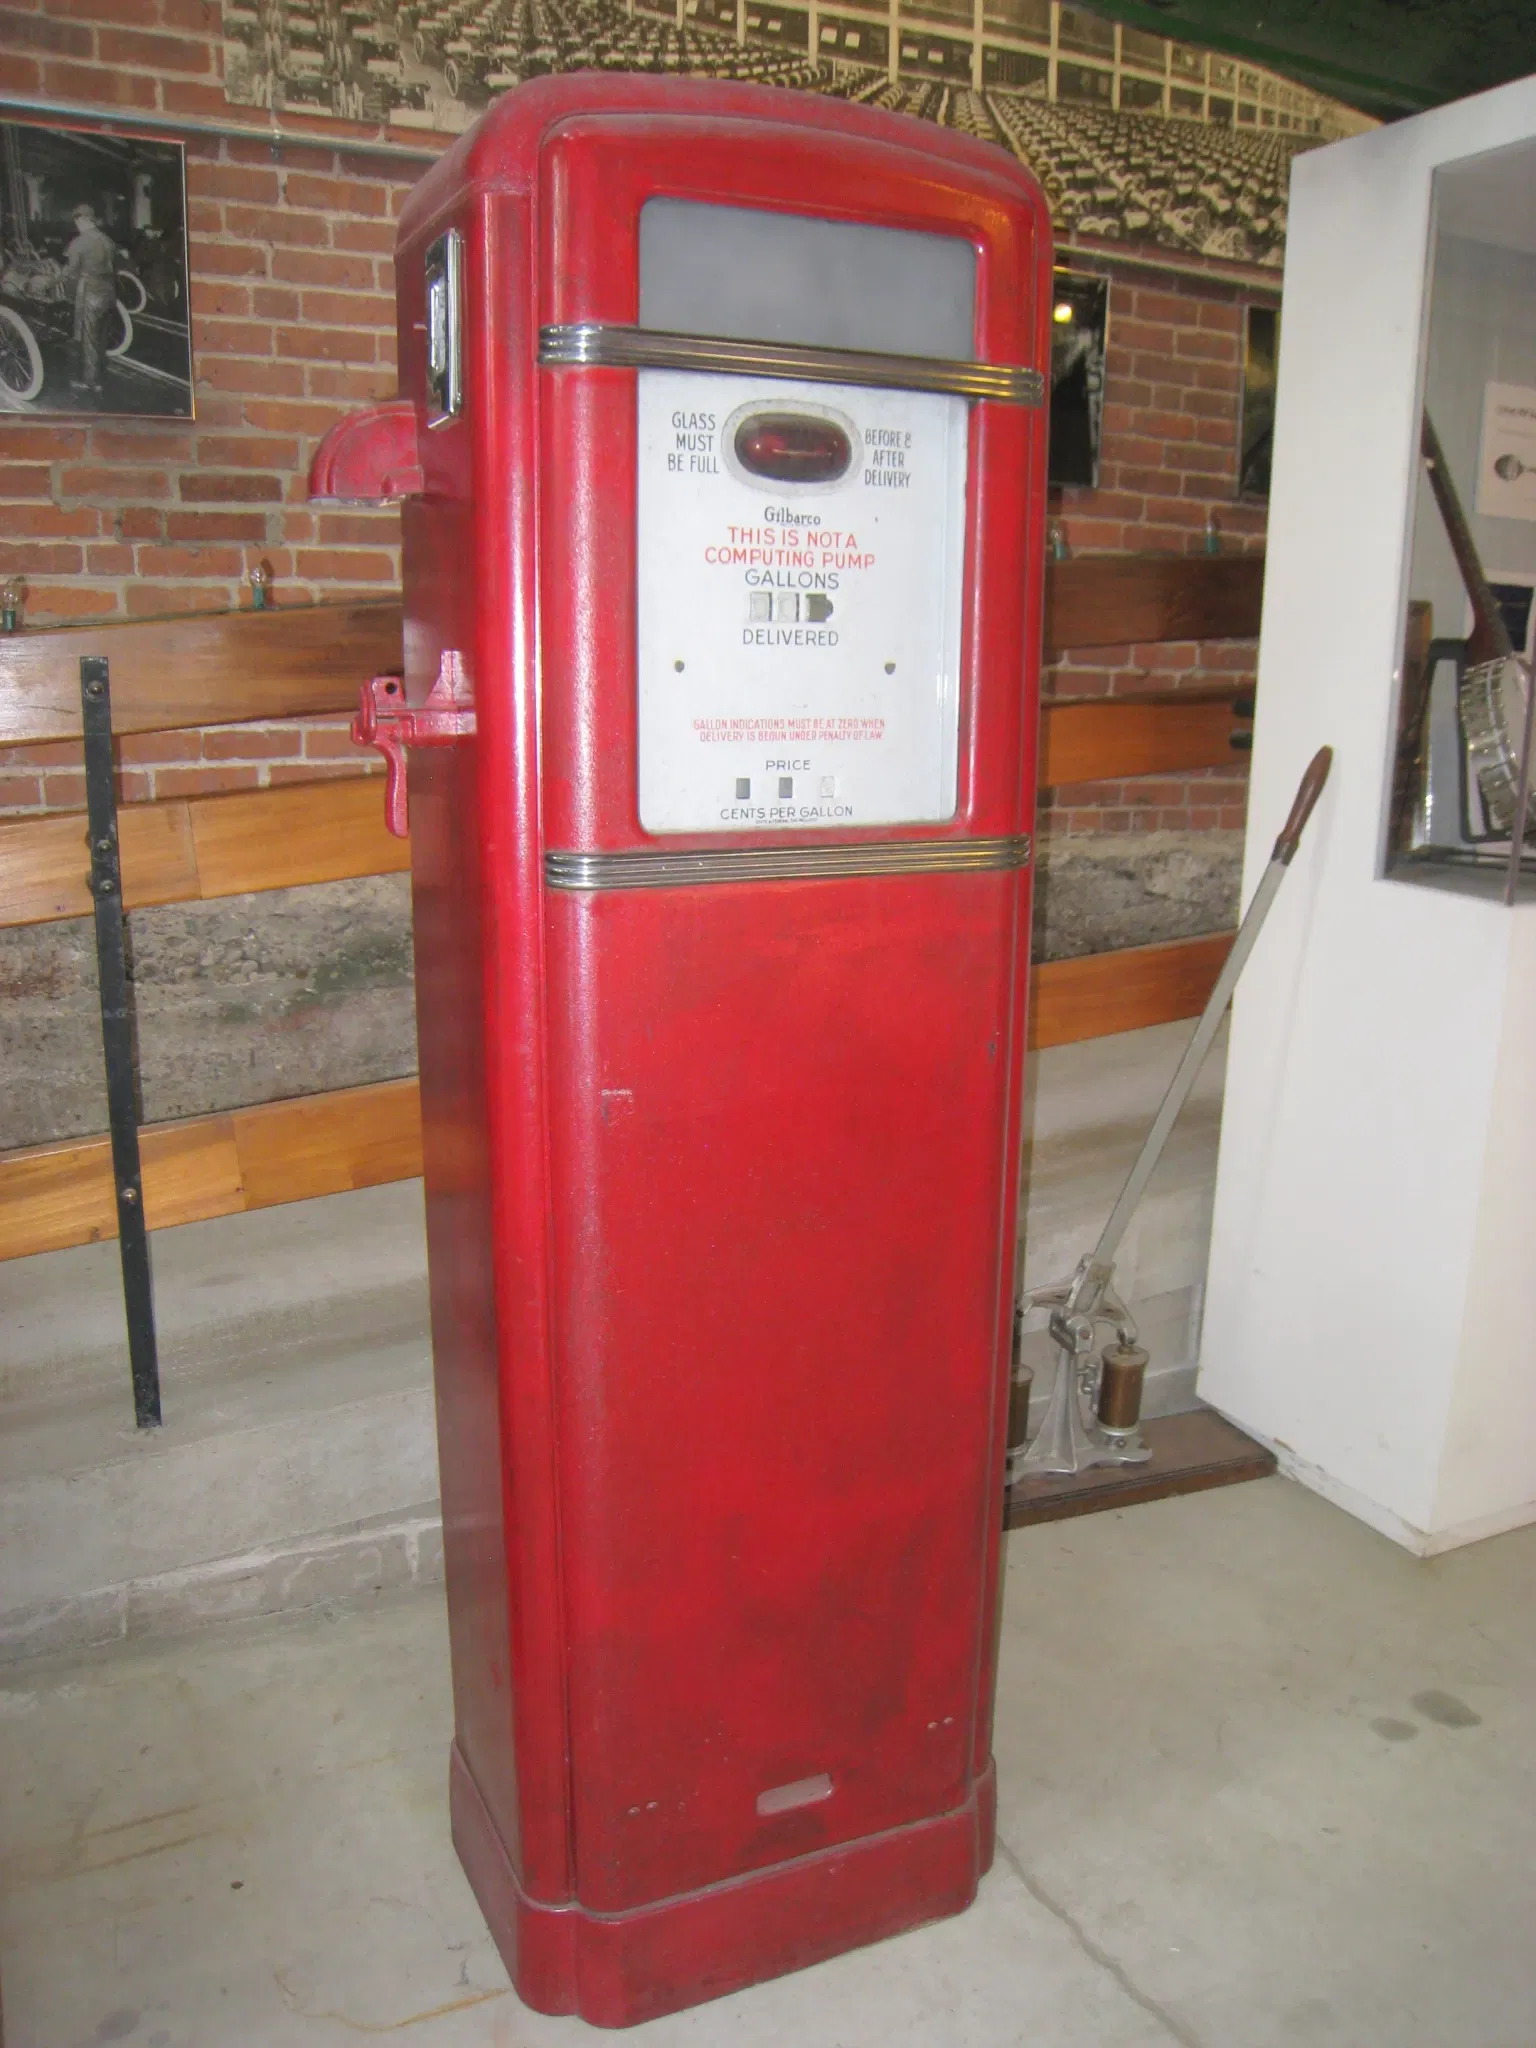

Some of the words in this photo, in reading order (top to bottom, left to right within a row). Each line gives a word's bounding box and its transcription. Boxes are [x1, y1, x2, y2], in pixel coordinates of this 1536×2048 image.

[672, 412, 716, 431] GLASS
[676, 434, 714, 452] MUST
[865, 428, 902, 448] BEFORE
[668, 454, 685, 473] BE
[690, 455, 720, 474] FULL
[872, 449, 905, 468] AFTER
[864, 468, 912, 488] DELIVERY
[764, 506, 821, 525] Gilbarco
[728, 526, 775, 545] THIS
[782, 528, 799, 546] IS
[807, 531, 844, 548] NOT
[845, 534, 858, 549] A
[705, 547, 814, 567] COMPUTING
[822, 552, 875, 569] PUMP
[745, 568, 839, 589] GALLONS
[743, 628, 839, 646] DELIVERED
[693, 718, 728, 730] GALLON
[730, 718, 785, 730] INDICATIONS
[787, 718, 811, 729] MUST
[813, 718, 825, 729] BE
[826, 718, 836, 729] AT
[838, 718, 859, 729] ZERO
[860, 718, 885, 730] WHEN
[700, 730, 744, 742] DELIVERY
[747, 731, 756, 741] IS
[758, 730, 787, 741] BEGUN
[789, 730, 817, 741] UNDER
[818, 730, 852, 741] PENALTY
[853, 730, 864, 741] OF
[864, 730, 883, 741] LAW
[766, 760, 811, 771] PRICE
[720, 808, 765, 820] CENTS
[770, 807, 796, 819] PER
[800, 806, 853, 818] GALLON
